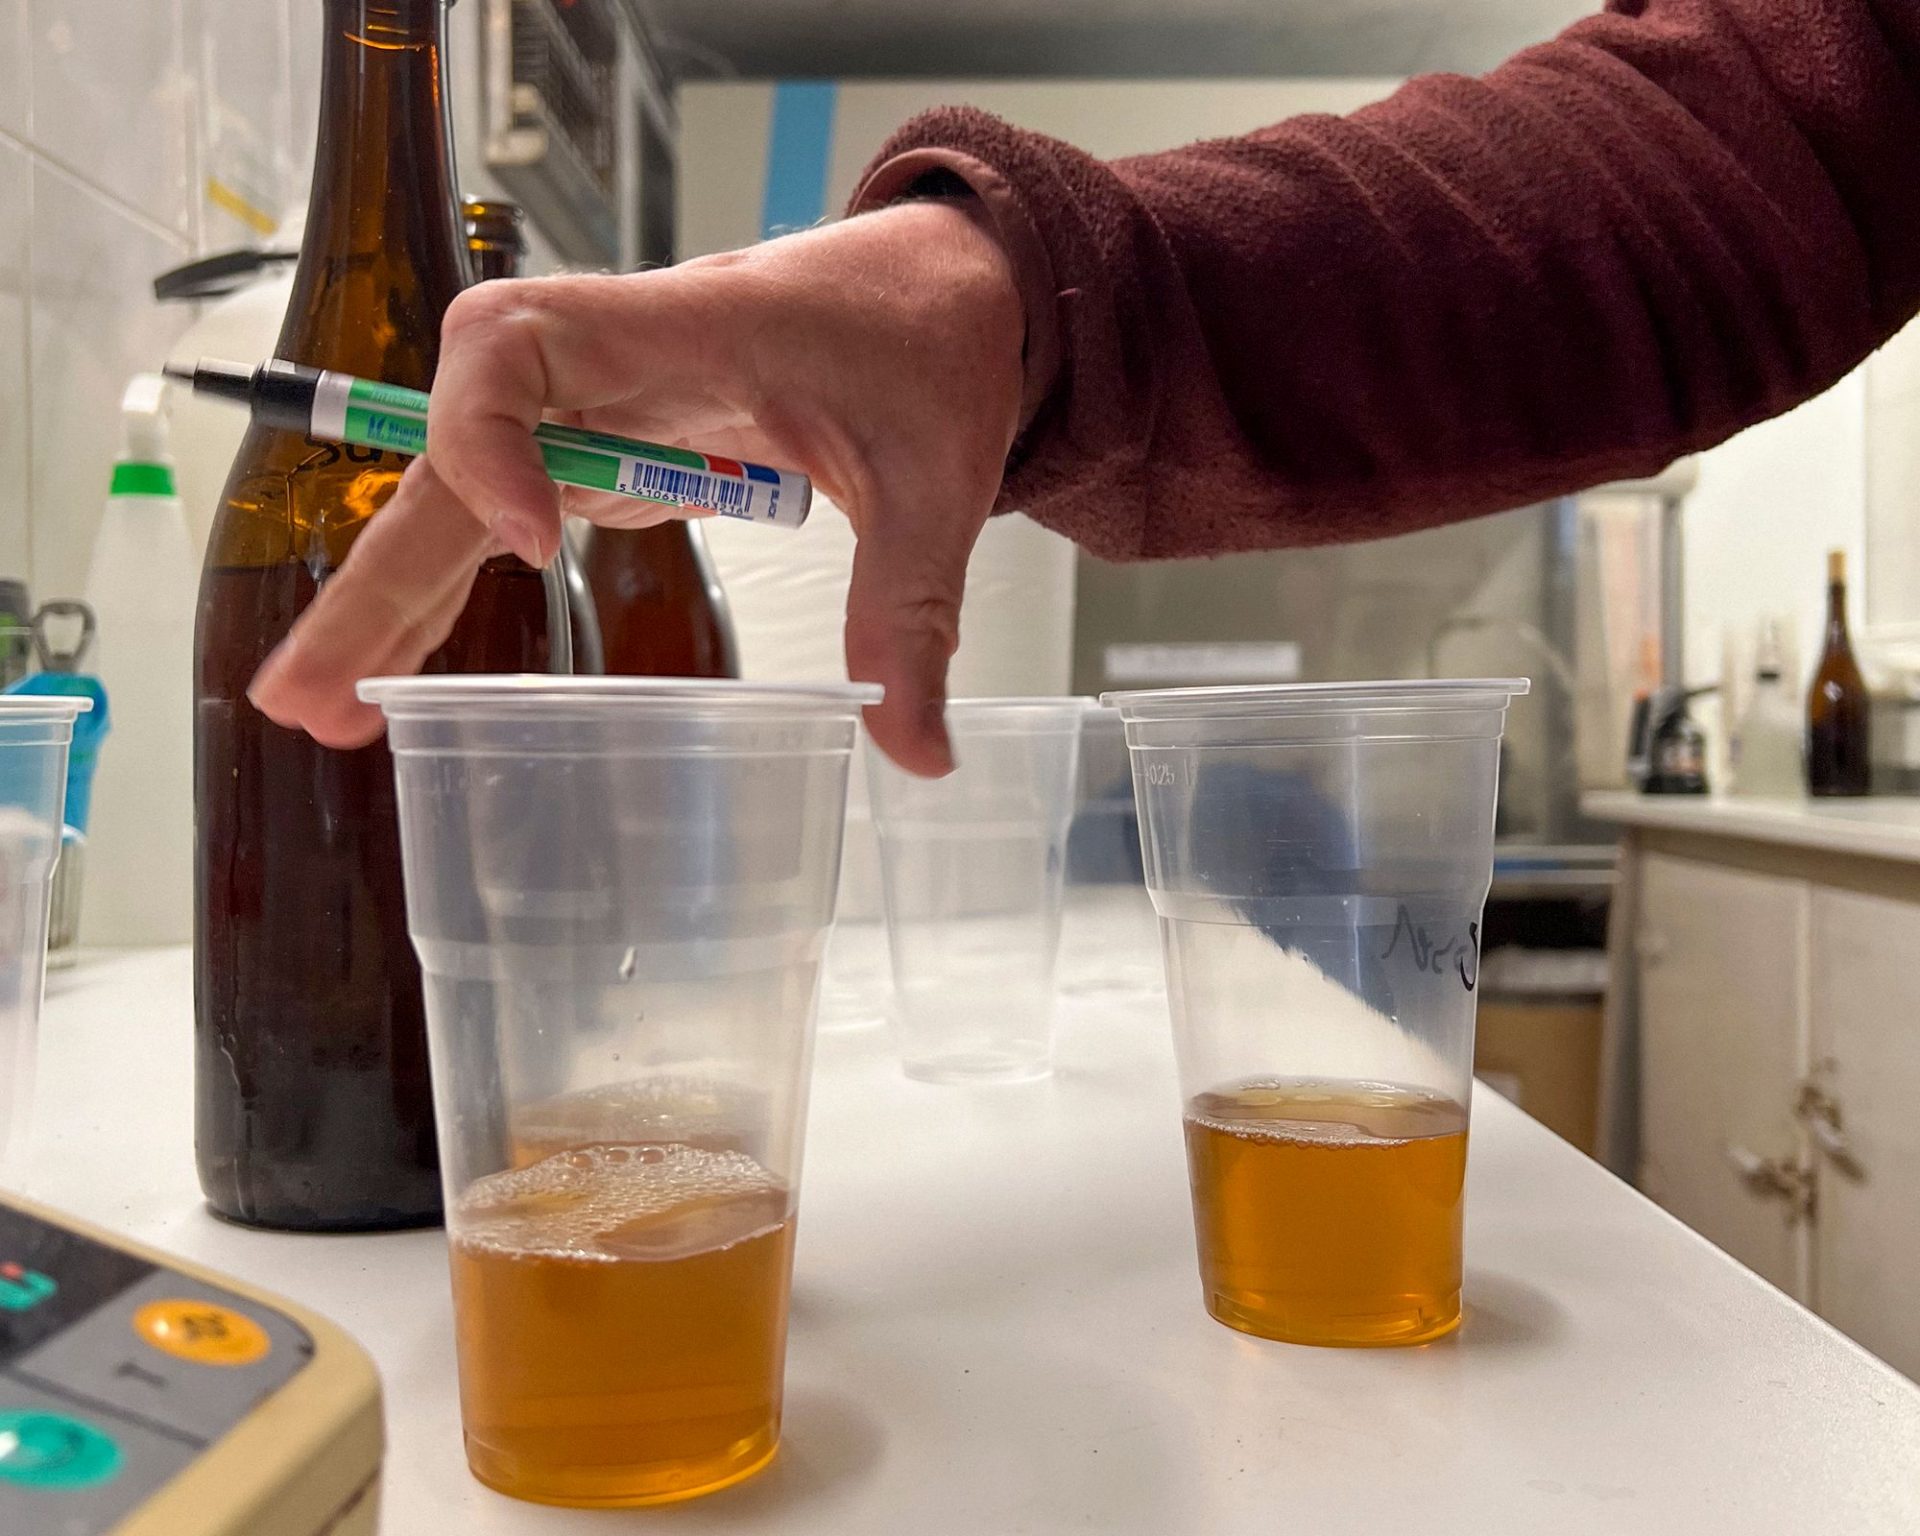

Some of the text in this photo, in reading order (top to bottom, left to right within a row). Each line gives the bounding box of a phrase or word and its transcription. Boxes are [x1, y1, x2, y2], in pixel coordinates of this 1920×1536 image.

[619, 483, 744, 515] 5 410631 063216
